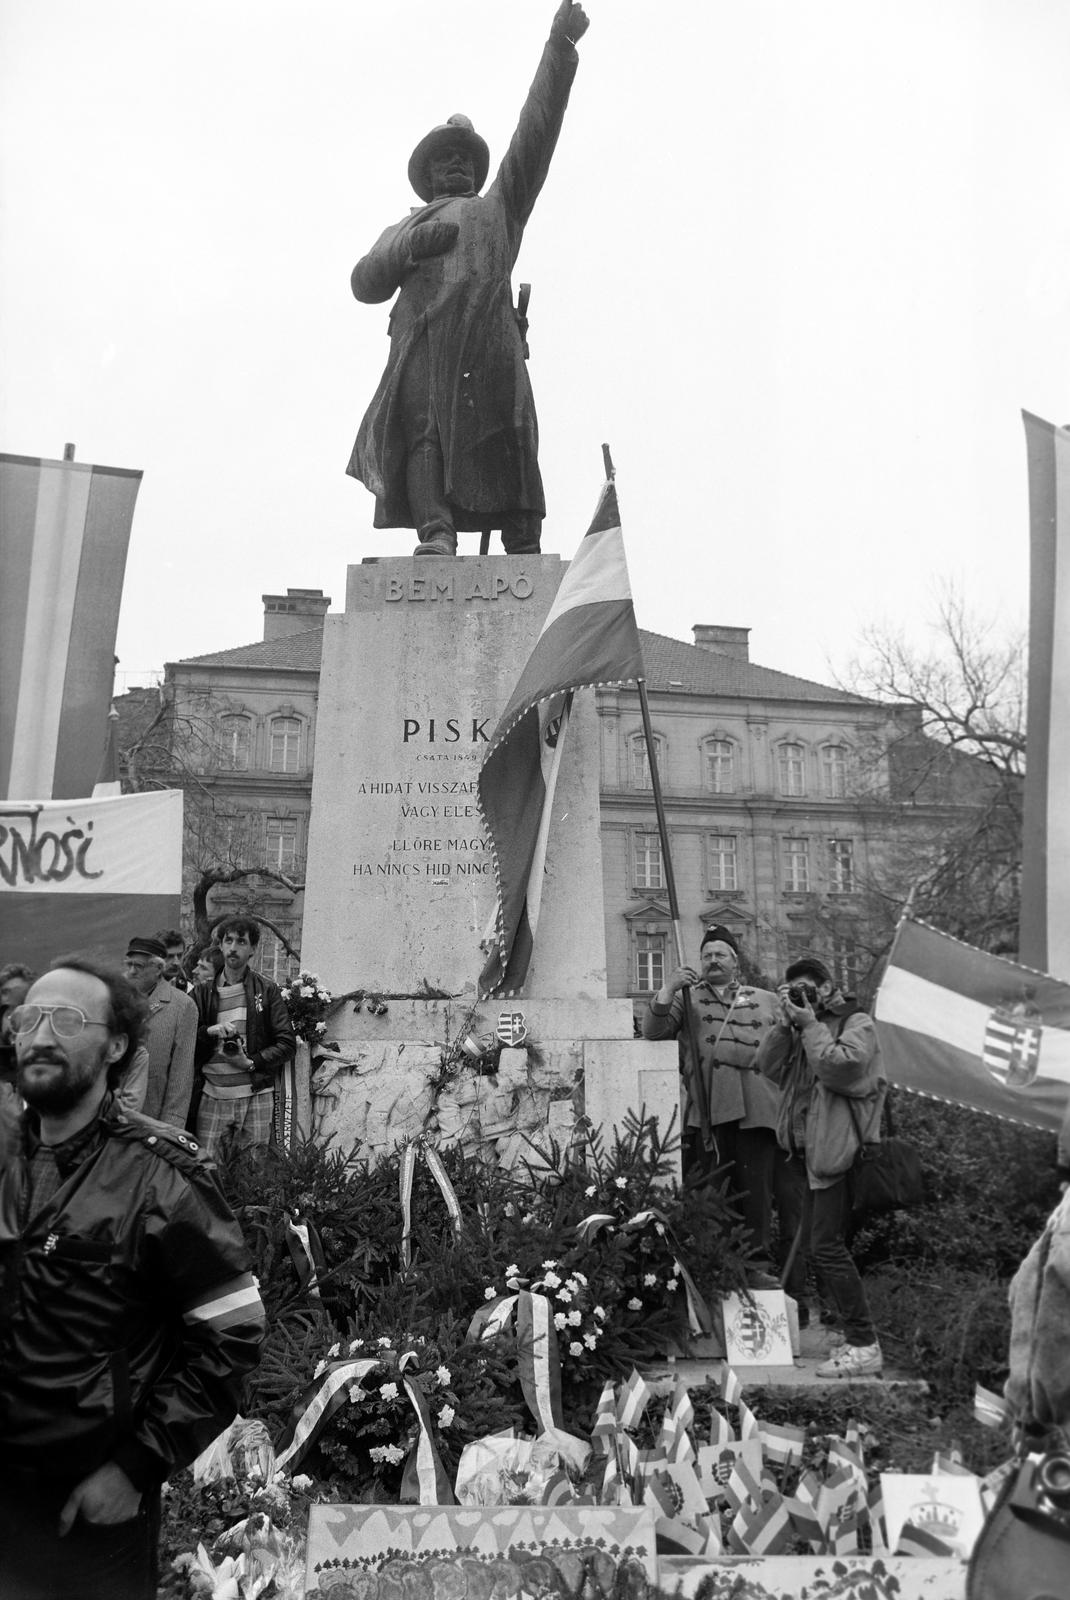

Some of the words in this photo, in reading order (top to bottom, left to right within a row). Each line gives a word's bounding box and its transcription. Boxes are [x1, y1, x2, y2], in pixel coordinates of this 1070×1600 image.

[386, 576, 455, 602] BEM
[358, 783, 366, 794] A
[370, 782, 413, 794] HIDAT
[401, 806, 440, 817] VAGY
[447, 839, 491, 851] MAGY
[353, 863, 373, 875] HA
[377, 863, 421, 875] NINCS
[426, 863, 450, 875] HID
[456, 863, 495, 875] NINC
